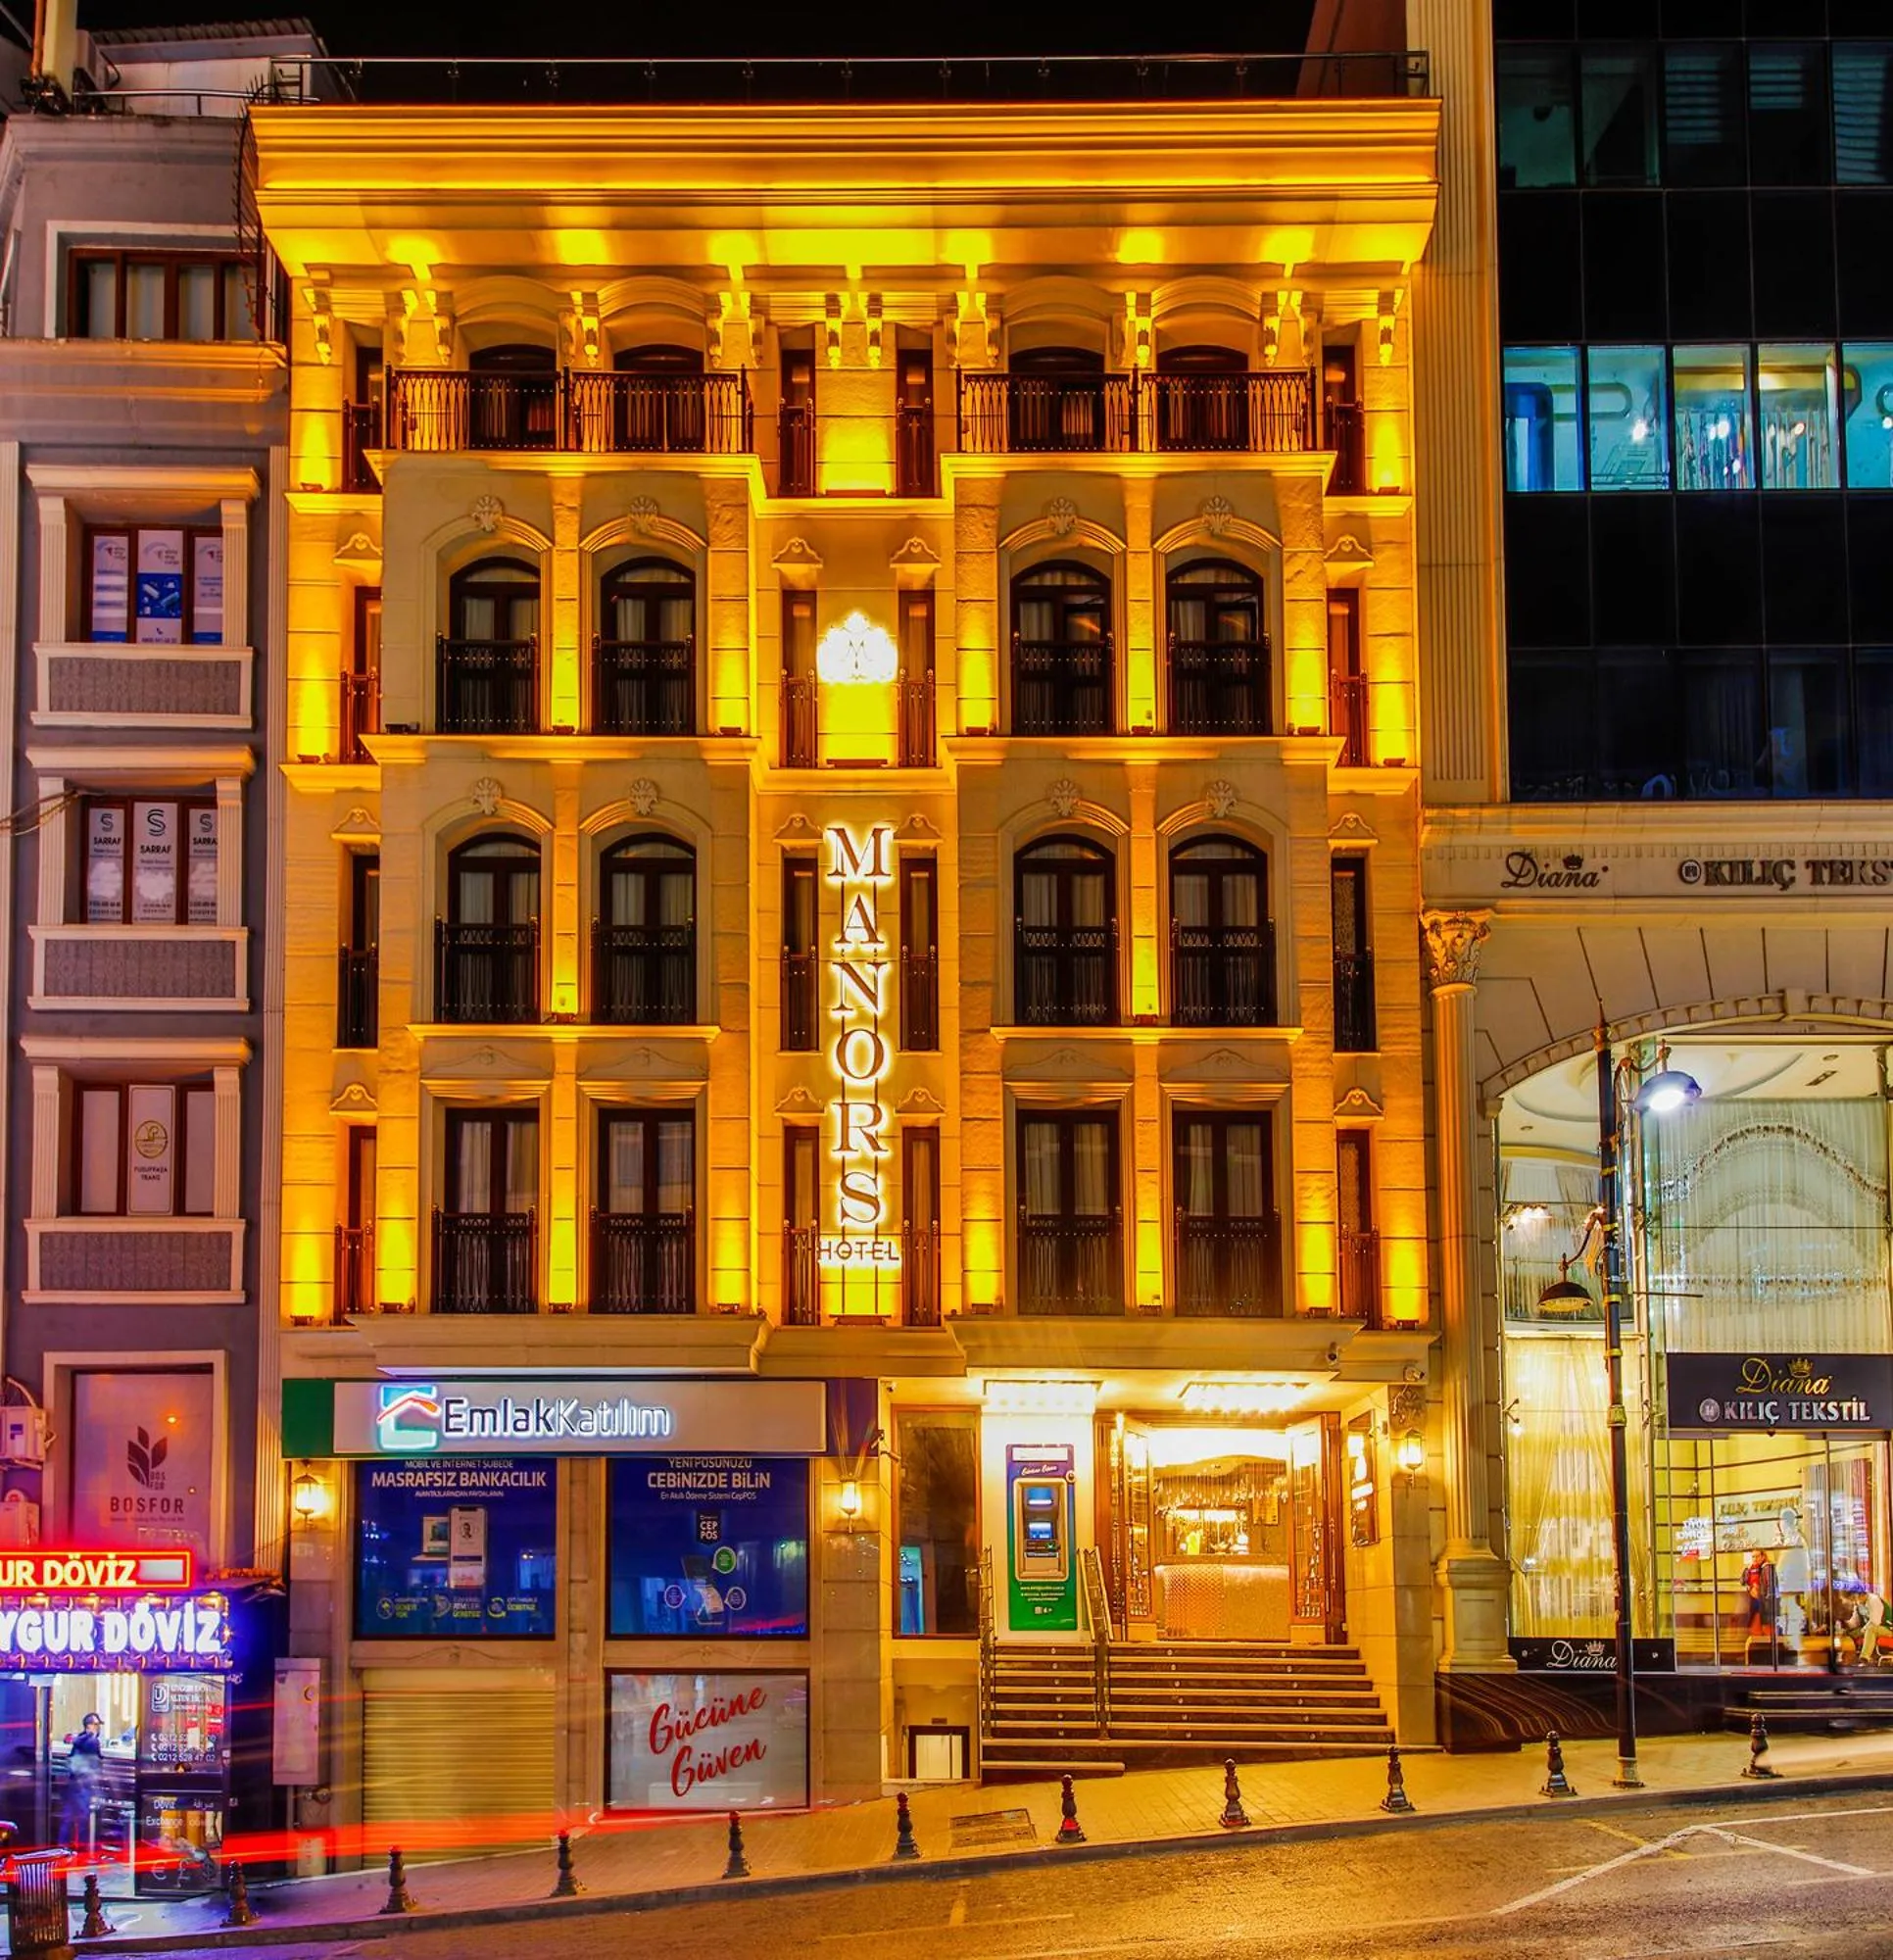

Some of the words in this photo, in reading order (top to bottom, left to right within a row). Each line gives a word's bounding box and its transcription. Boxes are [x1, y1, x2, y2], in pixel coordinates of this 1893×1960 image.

[93, 837, 121, 846] SARRAF
[140, 845, 171, 855] SARRAF
[1500, 852, 1601, 888] Diana
[1703, 858, 1796, 892] KILIÇ
[1805, 858, 1893, 887] TEKS
[826, 826, 892, 1224] MANORS
[818, 1241, 899, 1261] HOTEL
[1735, 1357, 1831, 1396] Diana
[1723, 1400, 1780, 1425] KILIÇ
[1788, 1396, 1870, 1421] TEKSTİL
[371, 1472, 457, 1488] MASRAFSIZ
[460, 1472, 547, 1488] BANKACILIK
[110, 1495, 184, 1515] BOSFOR
[700, 1521, 718, 1530] CEP
[700, 1531, 718, 1540] POS
[43, 1552, 137, 1586] DÖVİZ
[103, 1600, 221, 1653] DÖVİZ
[1546, 1640, 1617, 1669] Diana
[649, 1687, 767, 1755] Gücüne
[671, 1738, 767, 1797] Güven
